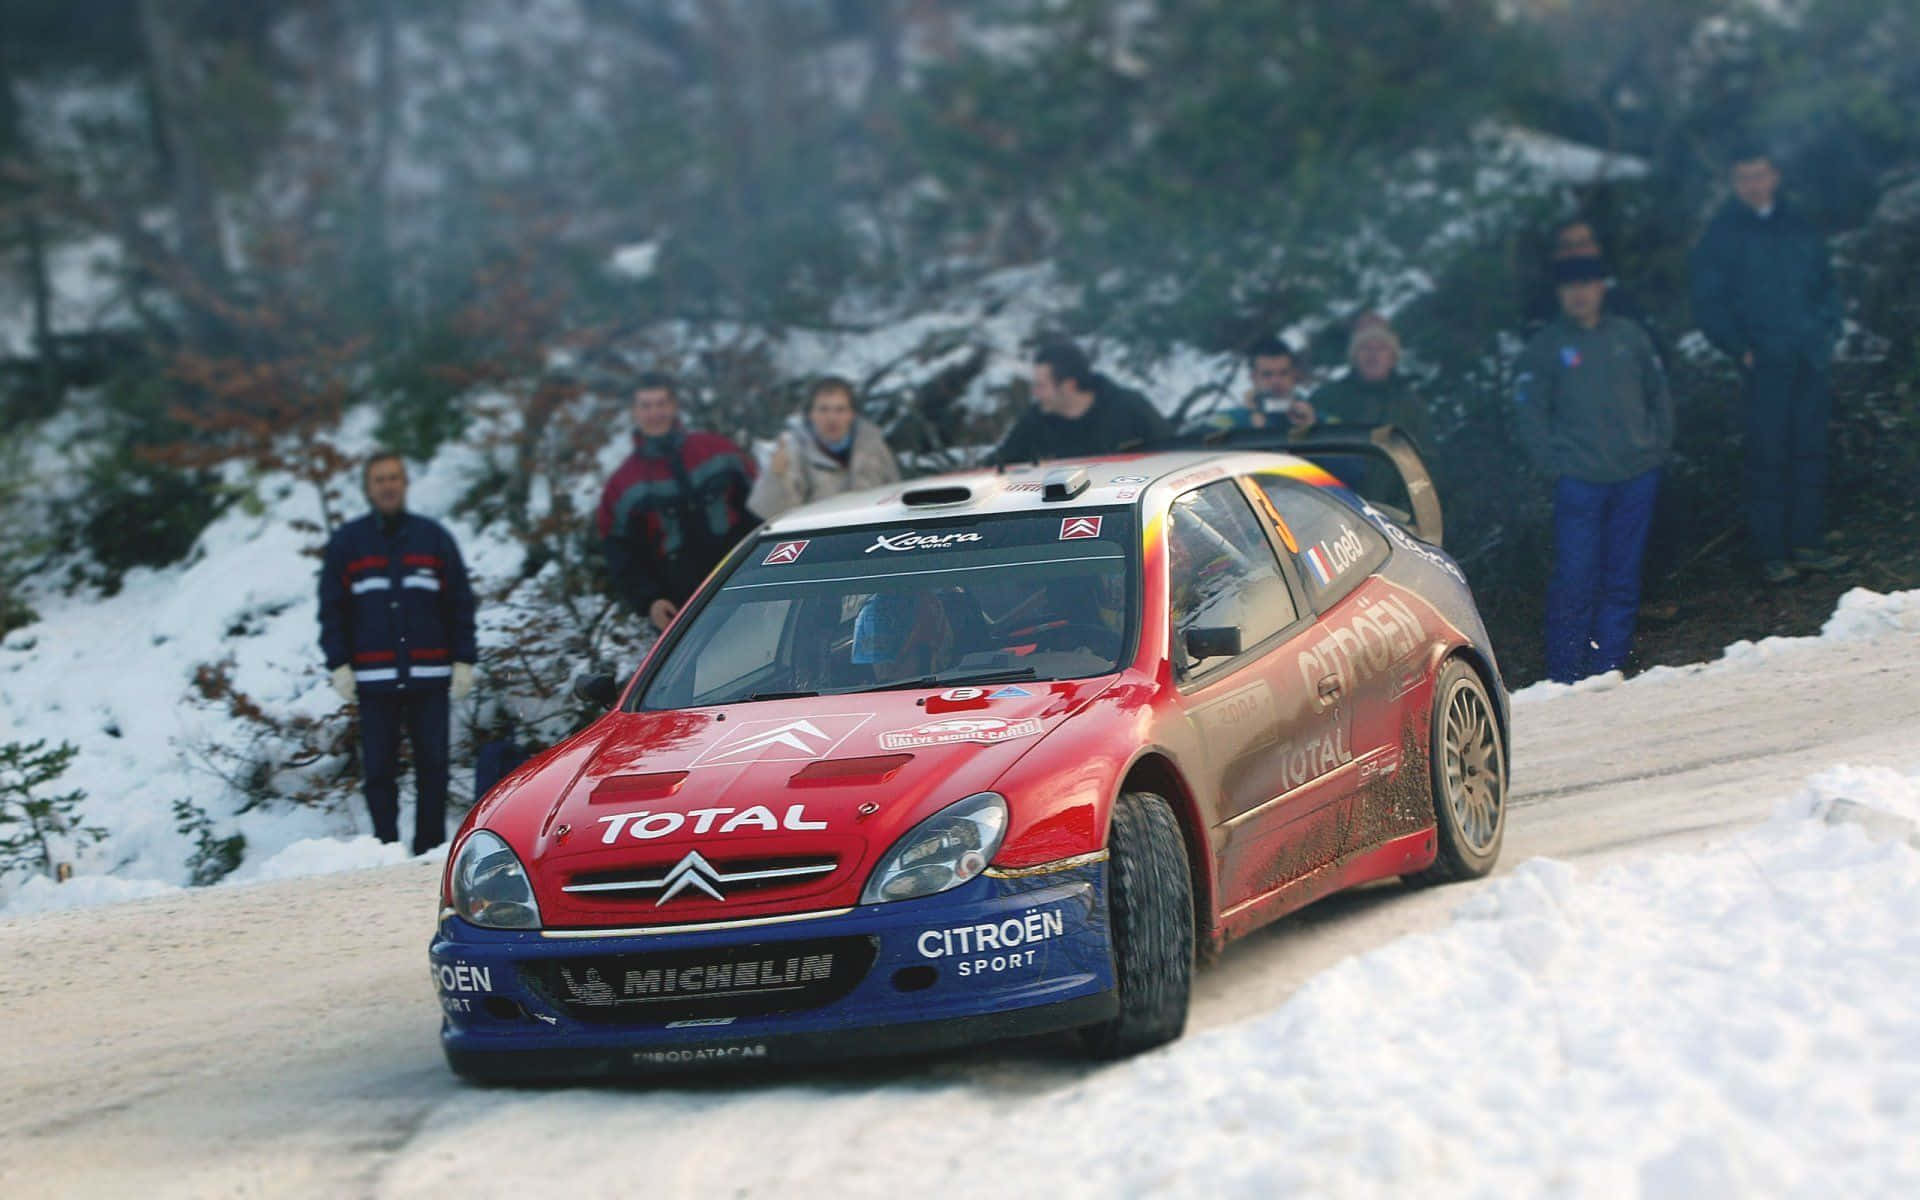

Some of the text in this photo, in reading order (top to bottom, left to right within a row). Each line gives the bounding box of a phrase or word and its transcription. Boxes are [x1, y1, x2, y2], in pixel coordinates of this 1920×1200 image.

[864, 531, 983, 553] Xsara
[1320, 524, 1364, 575] Loeb
[1298, 594, 1426, 714] CITROËN
[886, 734, 934, 748] RALLYE
[1278, 727, 1352, 791] TOTAL
[597, 805, 828, 844] TOTAL
[917, 908, 1064, 958] CITROËN
[623, 954, 834, 994] MICHELIN
[958, 950, 1036, 976] SPORT
